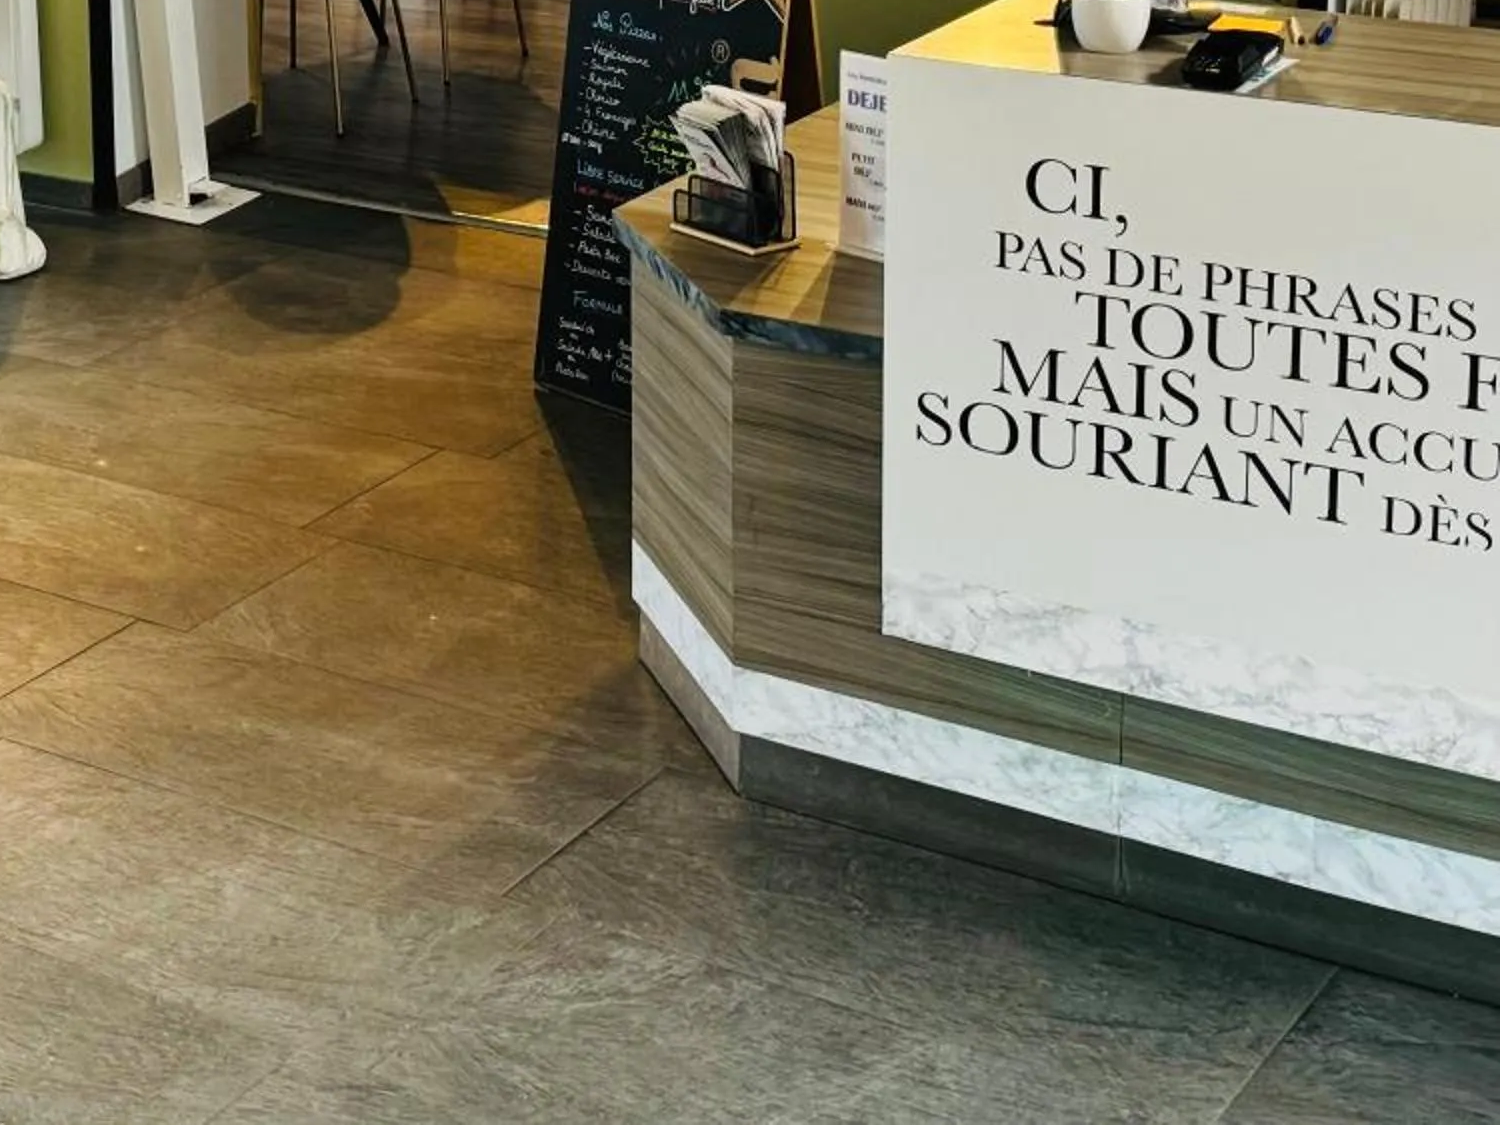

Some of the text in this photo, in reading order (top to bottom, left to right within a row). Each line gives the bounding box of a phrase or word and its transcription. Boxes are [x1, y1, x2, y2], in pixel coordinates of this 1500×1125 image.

[1025, 158, 1128, 237] CI,
[995, 230, 1478, 342] PAS DE PHRASES
[993, 339, 1200, 428] MAIS
[1220, 395, 1309, 448] UN
[1075, 291, 1431, 403] TOUTES
[916, 392, 1495, 552] SOURIANT DÈS
